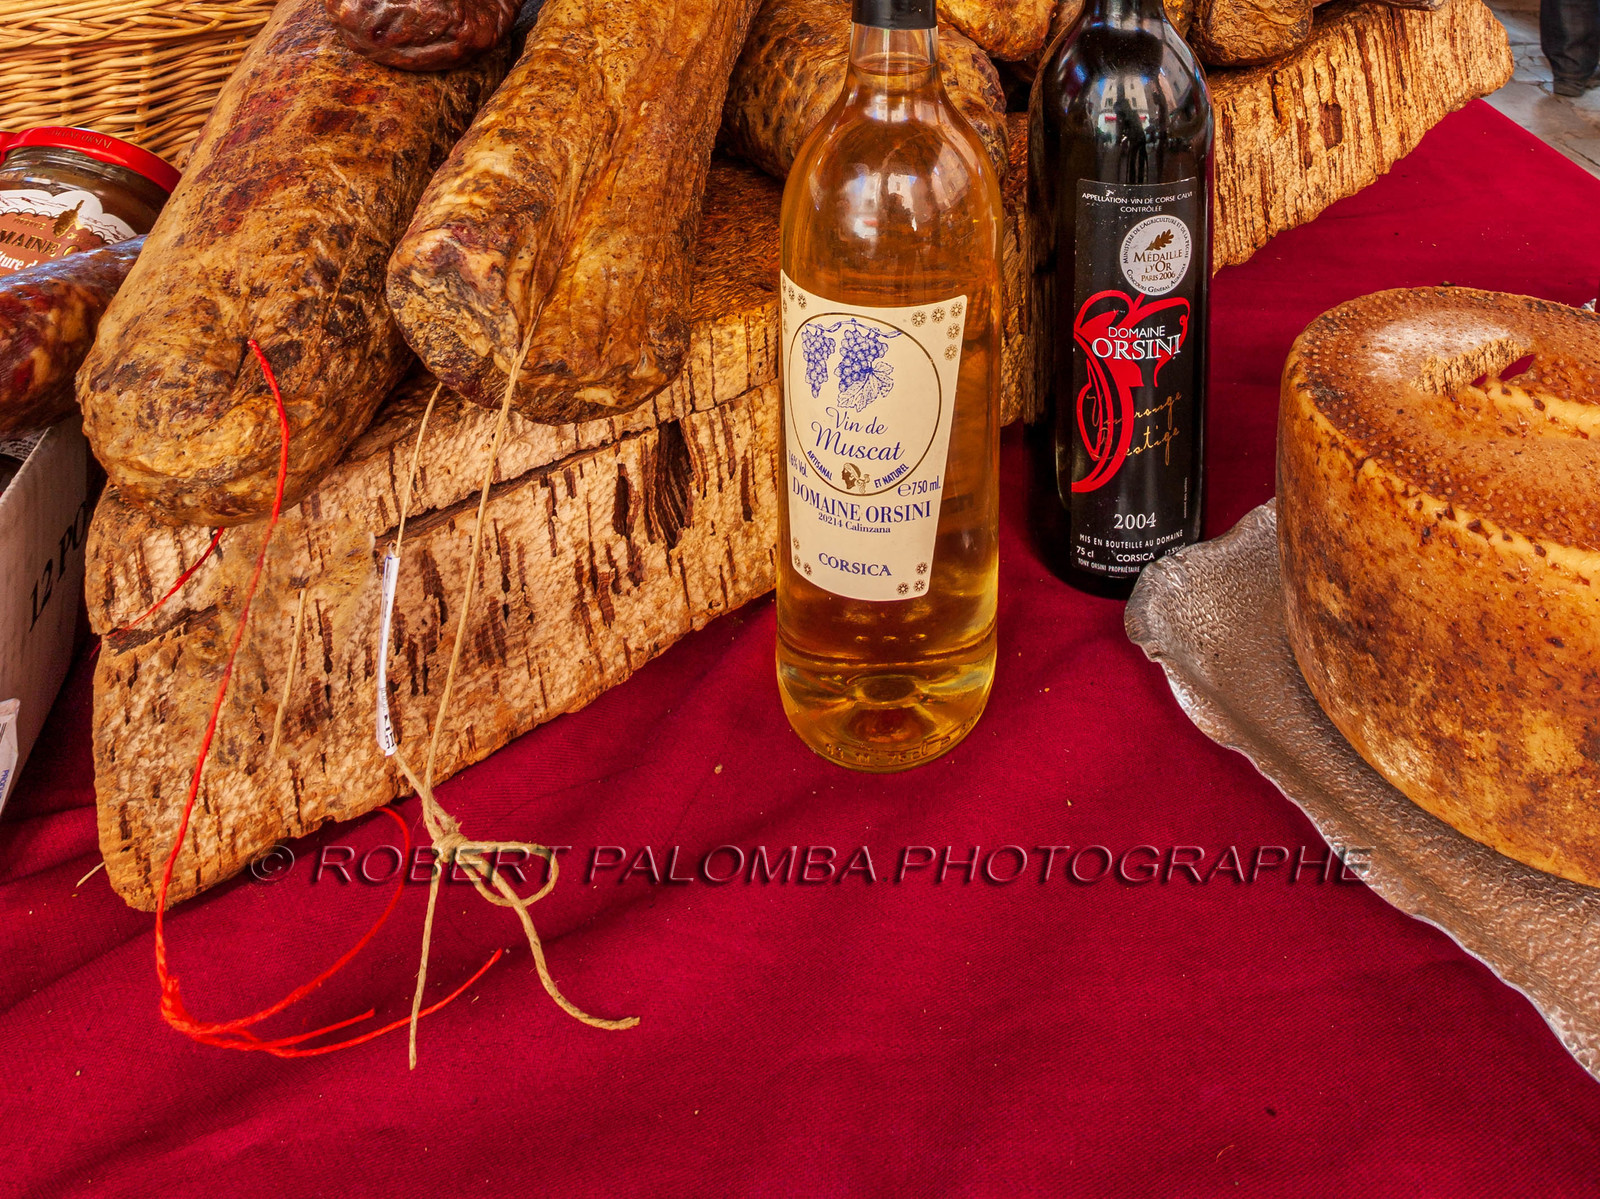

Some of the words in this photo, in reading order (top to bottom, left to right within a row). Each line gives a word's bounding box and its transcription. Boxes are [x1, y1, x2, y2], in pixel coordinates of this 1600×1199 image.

[1081, 192, 1128, 204] APPELLATION
[1130, 196, 1143, 205] VIN
[1144, 197, 1154, 205] DE
[1155, 194, 1176, 204] CORSE
[1177, 190, 1193, 201] CALVI
[1120, 204, 1162, 213] CONTRÔLÉE
[1123, 234, 1134, 264] MINISTÈRE
[1133, 248, 1183, 263] MÉDAILLE
[1141, 274, 1158, 282] PARIS
[1159, 271, 1176, 280] 2006
[1144, 260, 1172, 274] D'OR
[1126, 268, 1147, 292] CONCOURS
[1147, 284, 1170, 293] GÉNÉRAL
[1108, 325, 1166, 339] DOMAINE
[1091, 333, 1182, 361] ORSINI
[825, 406, 864, 433] Vin
[865, 416, 888, 435] de
[811, 421, 905, 461] Muscat
[807, 450, 834, 481] ARTISANAL
[874, 478, 882, 489] ET
[882, 463, 910, 486] NATUREL
[792, 476, 861, 522] DOMAINE
[865, 500, 932, 524] ORSINI
[818, 512, 843, 528] 20214
[845, 521, 891, 534] Calinzana
[1113, 512, 1157, 530] 2004
[1079, 533, 1091, 544] MIS
[1093, 537, 1103, 546] EN
[1105, 540, 1143, 549] BOUTEILLE
[1145, 539, 1154, 547] AU
[1156, 529, 1183, 546] DOMAINE
[1076, 545, 1086, 556] 75
[1087, 549, 1095, 558] cl
[1116, 552, 1155, 563] CORSICA
[818, 552, 893, 577] CORSICA
[1090, 562, 1107, 571] ORSINI
